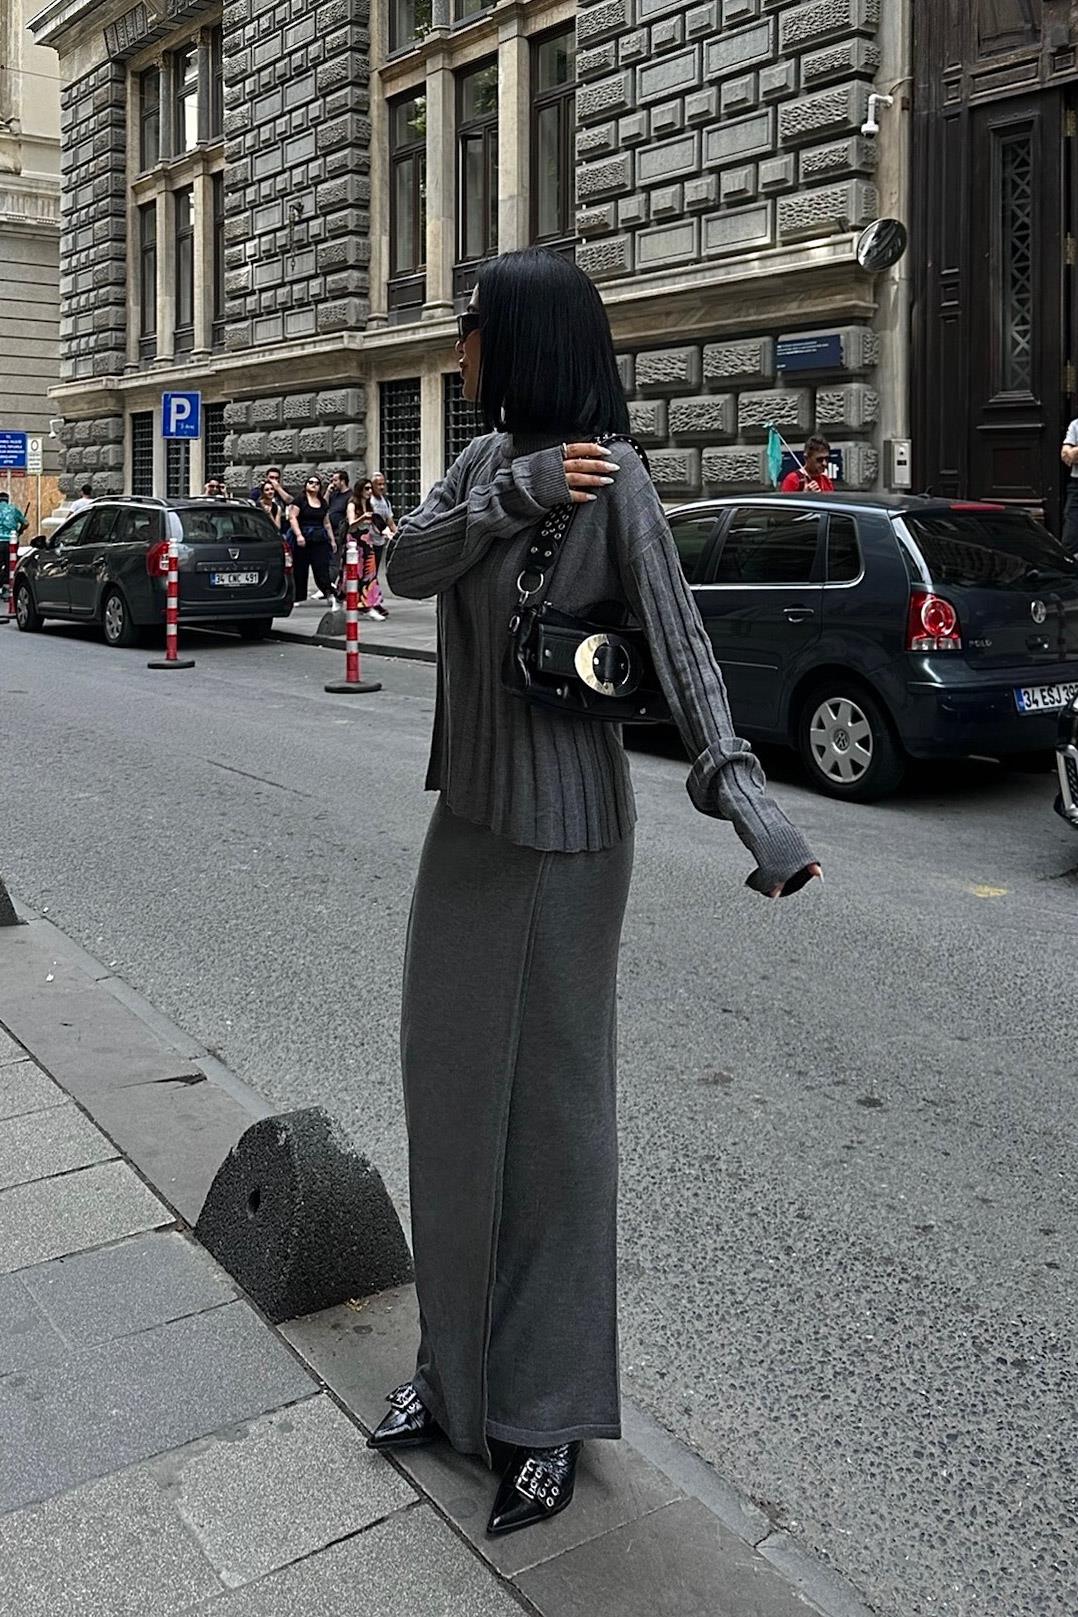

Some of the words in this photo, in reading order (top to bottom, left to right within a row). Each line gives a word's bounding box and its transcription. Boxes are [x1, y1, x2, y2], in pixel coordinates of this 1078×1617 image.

[170, 397, 191, 433] P
[215, 574, 225, 584] 34
[1023, 689, 1039, 708] 34
[1040, 686, 1062, 706] ESJ
